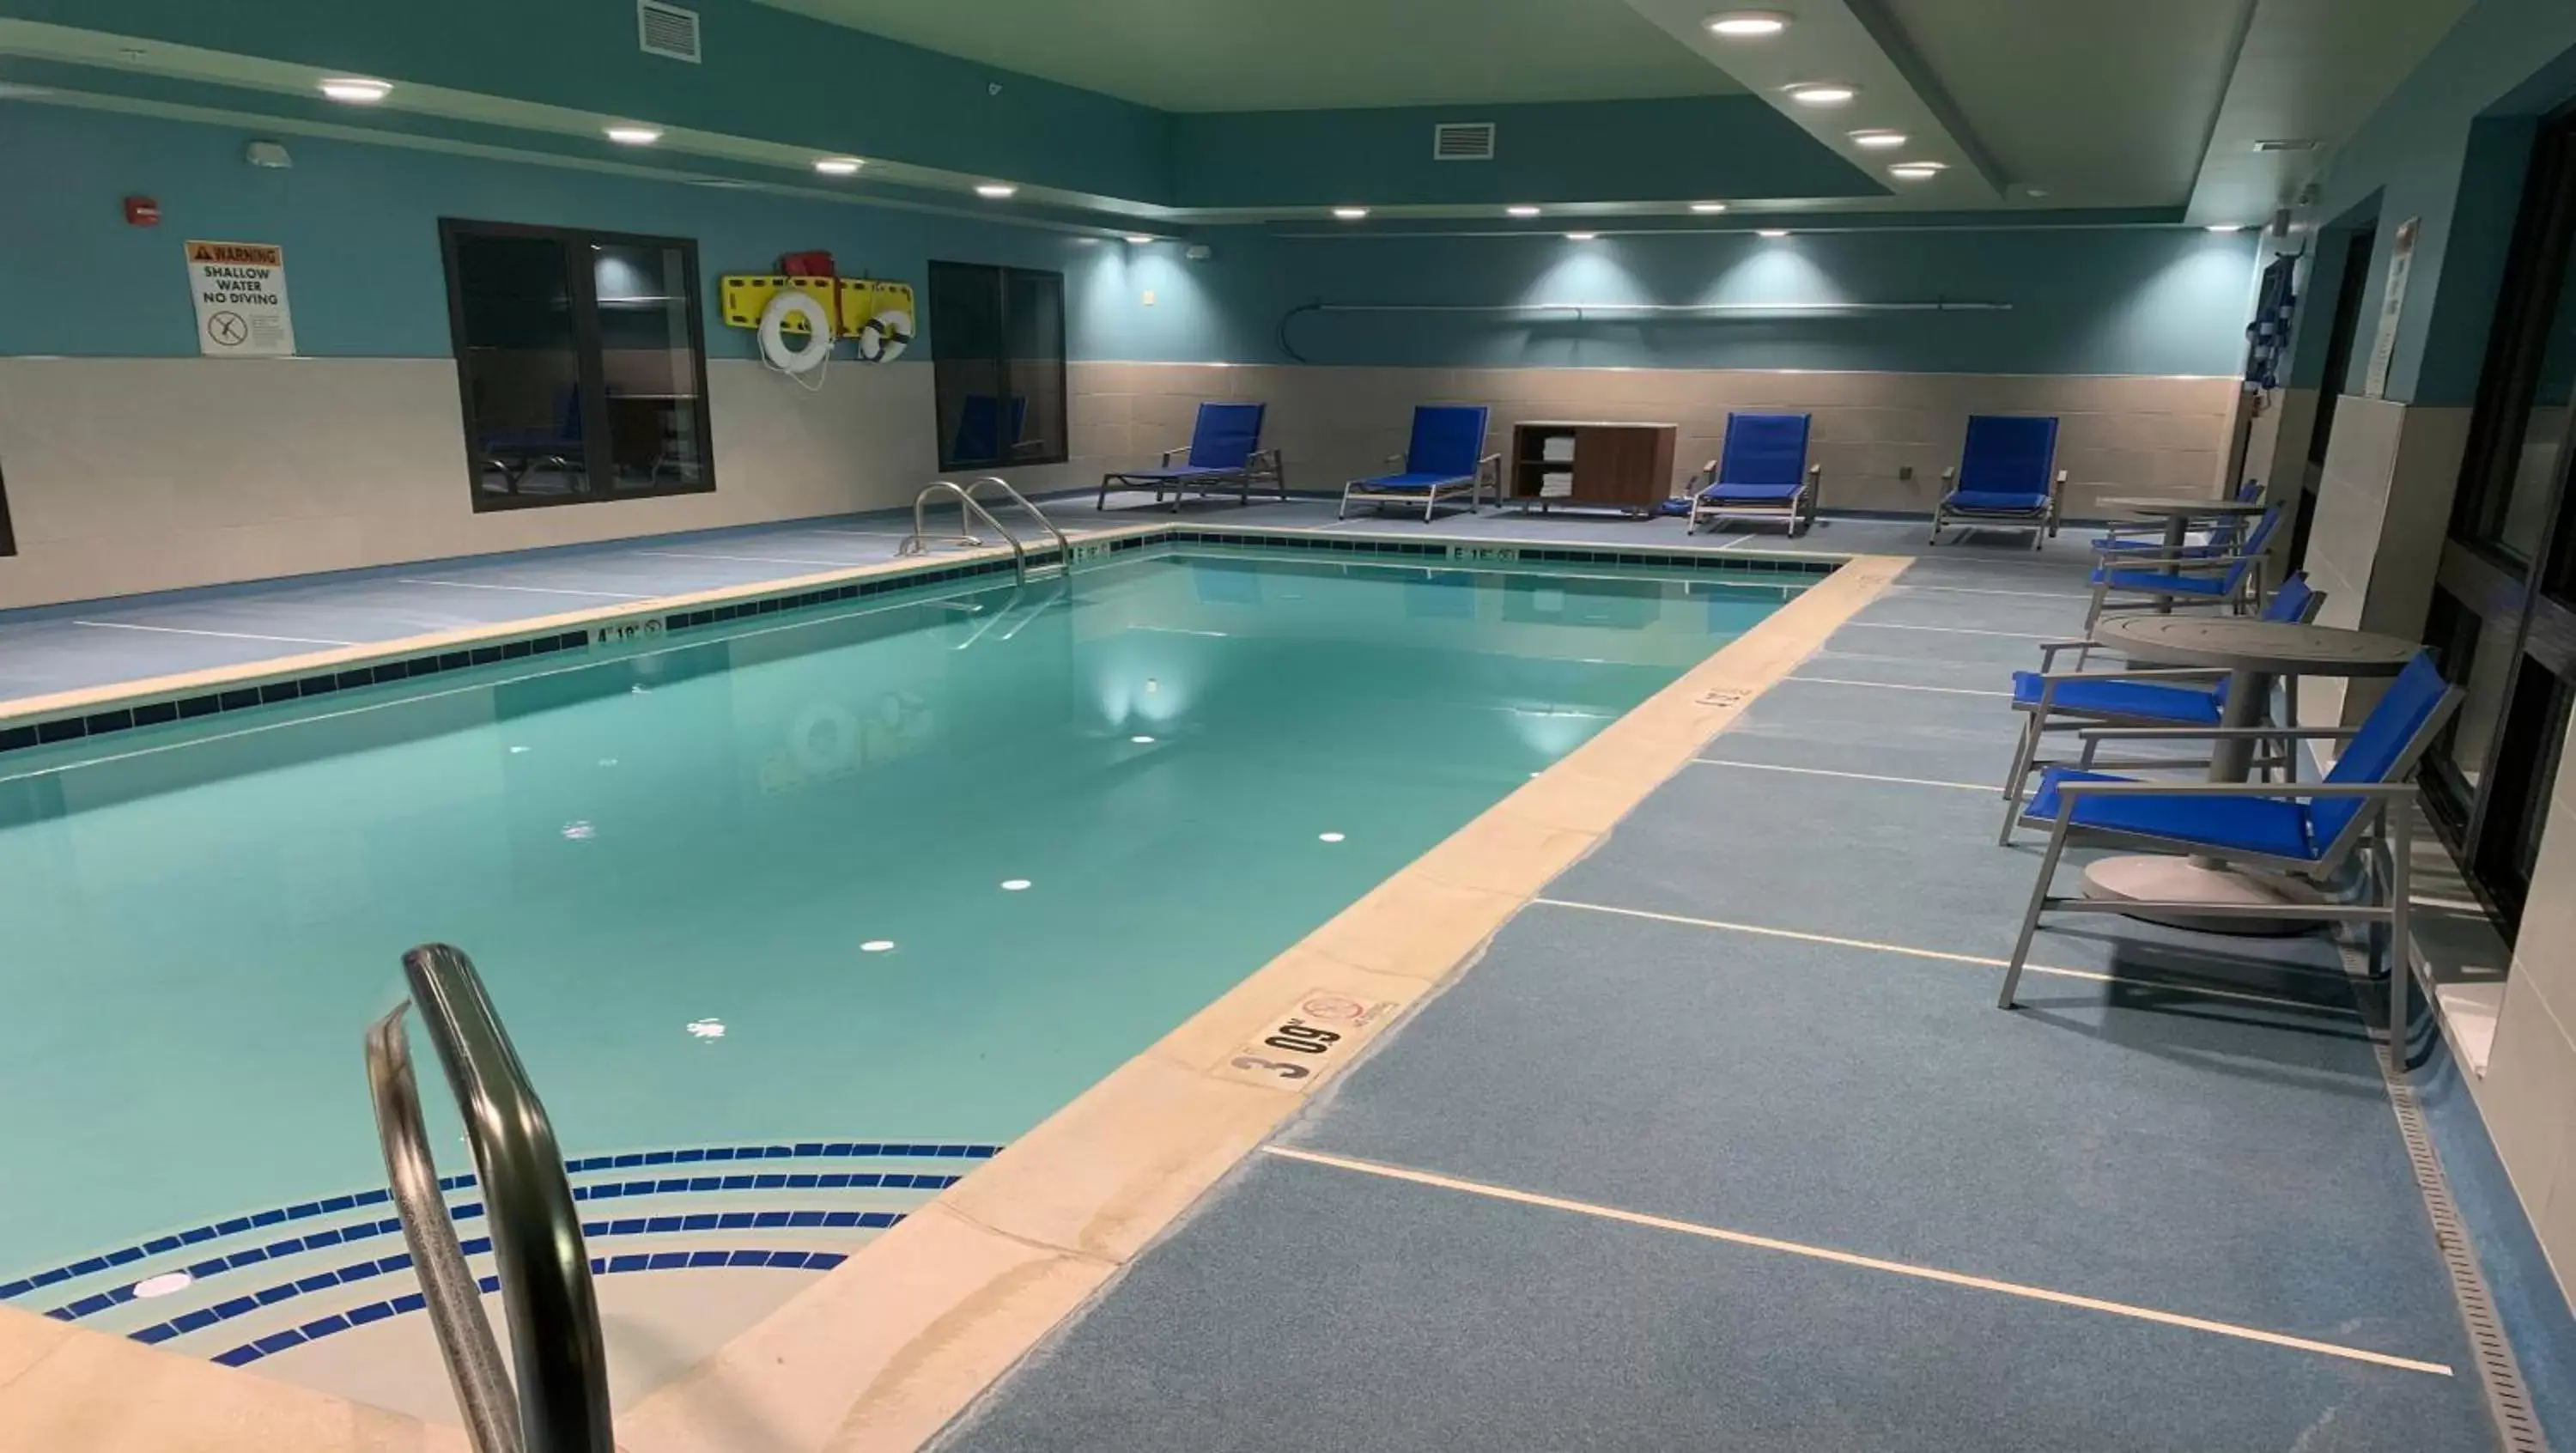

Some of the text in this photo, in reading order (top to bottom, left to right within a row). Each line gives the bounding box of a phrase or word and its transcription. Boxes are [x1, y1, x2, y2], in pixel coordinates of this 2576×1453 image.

[213, 246, 276, 263] WARNING
[204, 266, 270, 278] SHALLOW
[216, 280, 262, 291] WATER
[204, 293, 278, 305] NO DIVING
[1230, 1056, 1310, 1079] 3
